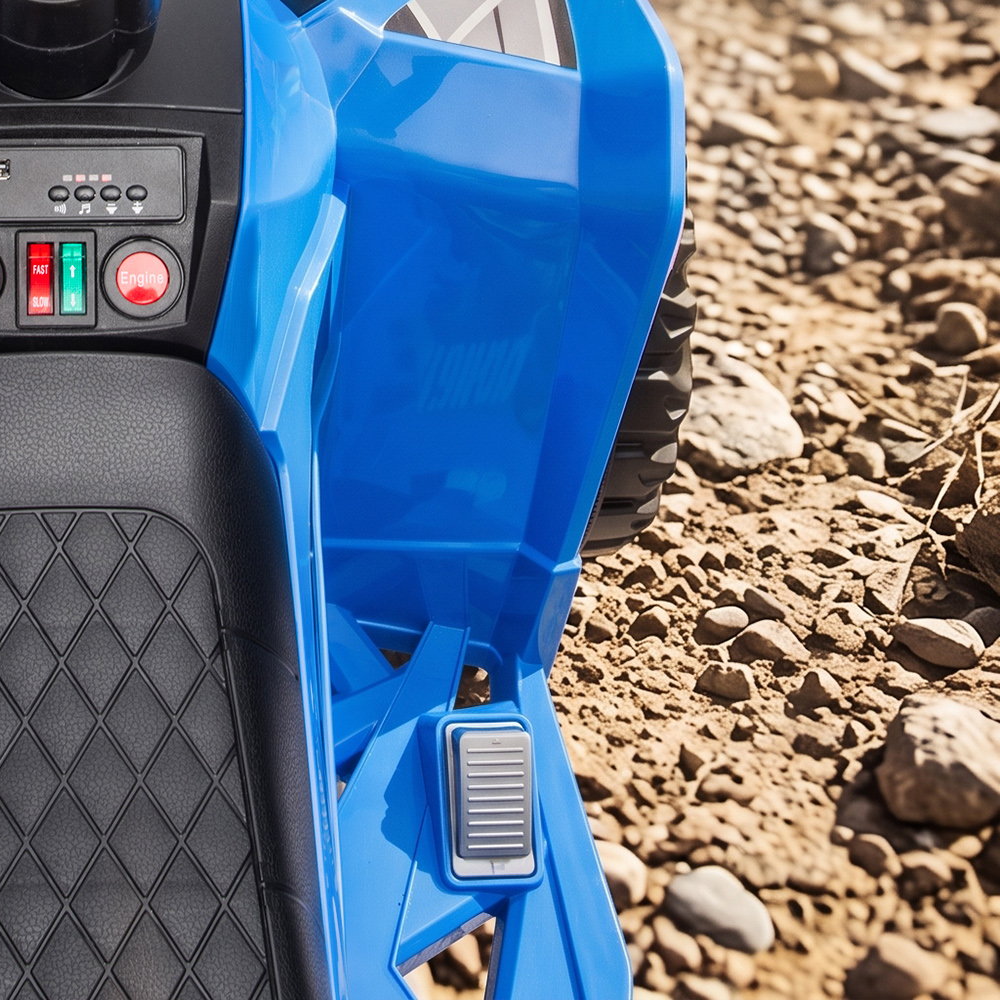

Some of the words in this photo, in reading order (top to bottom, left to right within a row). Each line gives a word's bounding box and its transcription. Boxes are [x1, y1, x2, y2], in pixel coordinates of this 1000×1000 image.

[32, 264, 50, 275] FAST
[120, 271, 164, 288] Engine
[32, 296, 50, 308] SLOW
